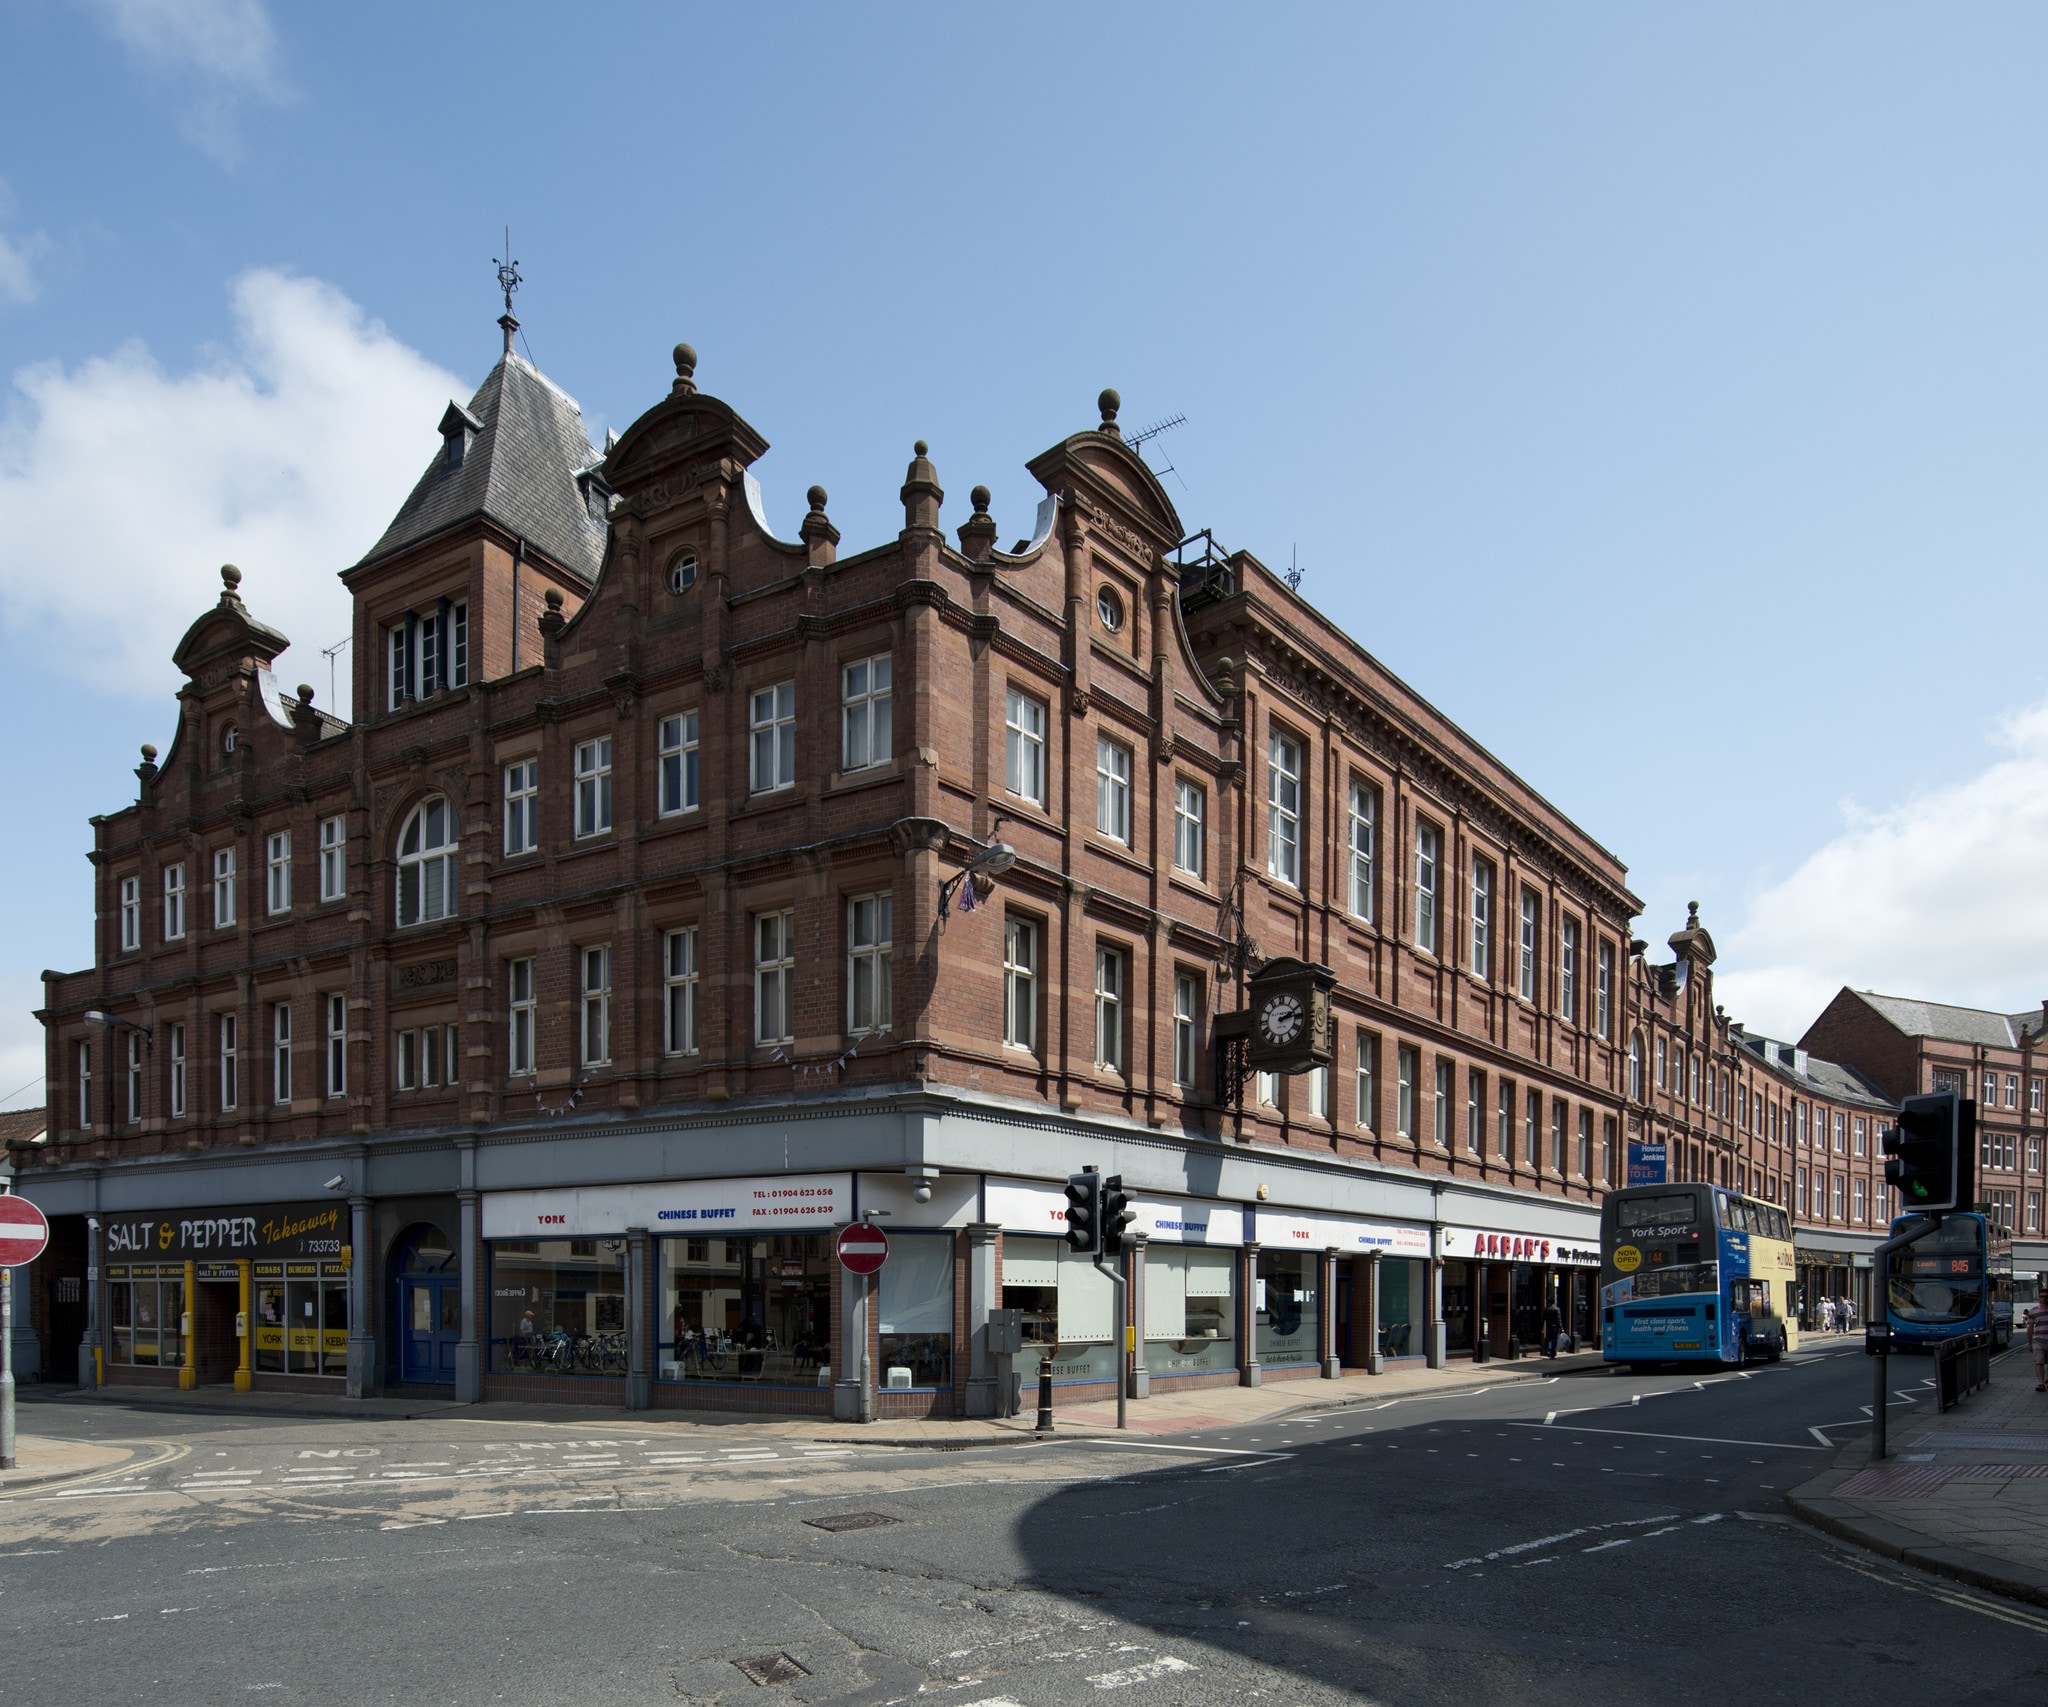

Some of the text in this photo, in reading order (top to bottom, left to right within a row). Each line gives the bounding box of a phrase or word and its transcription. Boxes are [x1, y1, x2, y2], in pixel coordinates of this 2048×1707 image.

[800, 1189, 816, 1197] 623
[817, 1188, 833, 1196] 656
[658, 1208, 736, 1220] CHINESE BUFFET
[752, 1208, 766, 1216] FAX
[773, 1207, 799, 1215] 01904
[800, 1206, 816, 1214] 626
[1050, 1210, 1068, 1220] YO
[538, 1215, 566, 1224] YORK
[262, 1208, 338, 1245] Takeaway
[1155, 1220, 1207, 1232] CHINESE BUFFET
[1631, 1225, 1688, 1237] York Sport
[108, 1216, 258, 1252] SALT & PEPPER
[1292, 1230, 1310, 1239] YORK
[308, 1239, 340, 1252] 733733
[1358, 1236, 1376, 1245] CHINESE
[1377, 1238, 1392, 1246] BUFFET
[1475, 1234, 1550, 1257] AKBAR'S
[1652, 1252, 1662, 1262] 44
[256, 1266, 281, 1274] KEBABS
[288, 1266, 316, 1274] BURGERS
[1951, 1260, 1969, 1272] 845
[262, 1334, 282, 1344] YORK
[295, 1336, 315, 1345] BEST
[325, 1337, 348, 1346] KEBA
[1035, 1365, 1090, 1376] CESE BUFFET
[298, 1440, 650, 1459] NO ENTRY
